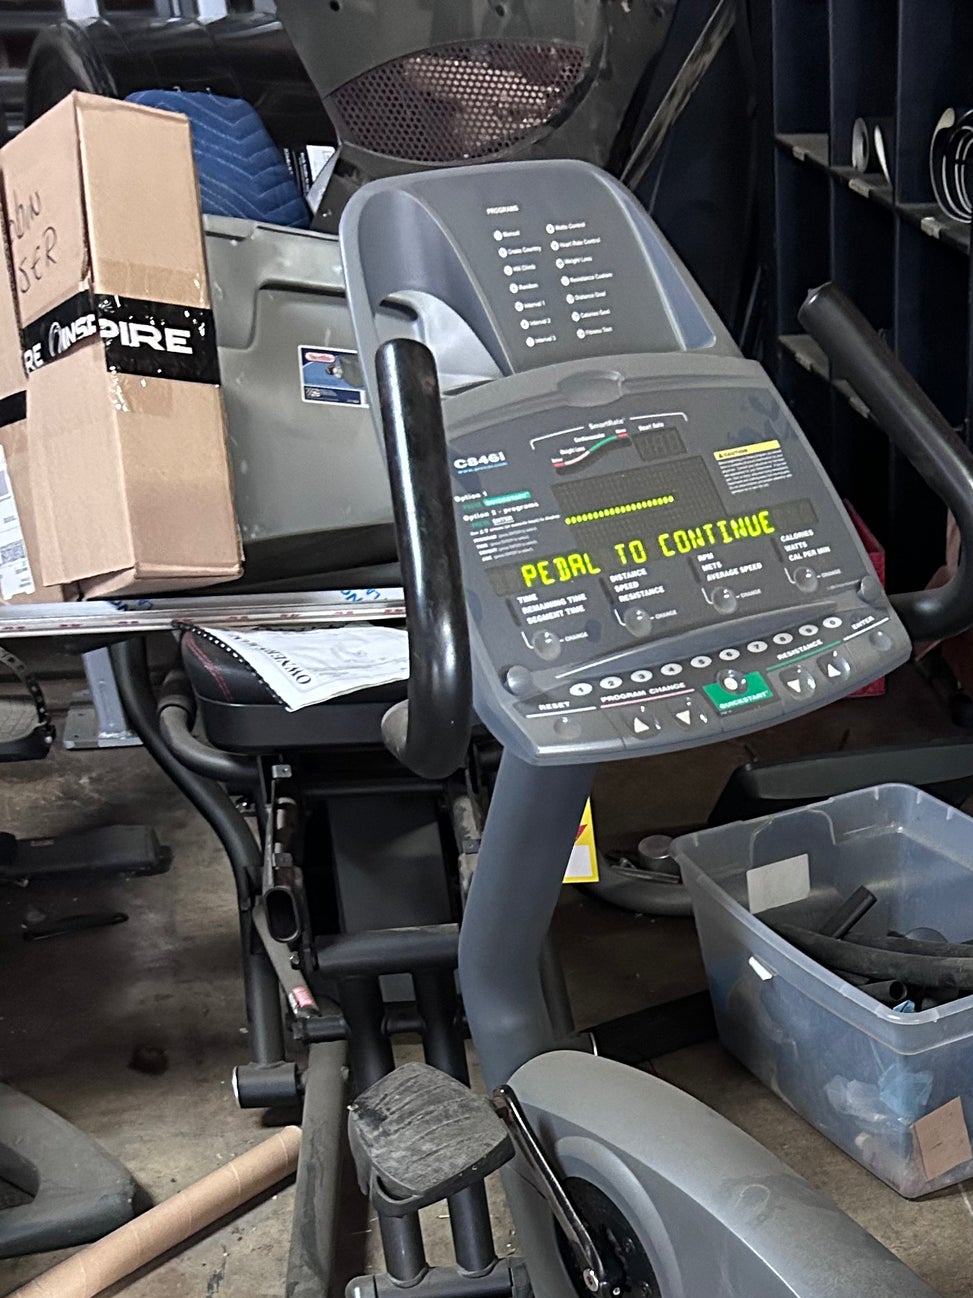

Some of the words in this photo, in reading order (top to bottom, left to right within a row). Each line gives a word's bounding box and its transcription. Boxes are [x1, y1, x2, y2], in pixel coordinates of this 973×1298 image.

[453, 491, 481, 503] Option
[462, 511, 489, 522] Option
[503, 501, 540, 514] programs
[780, 529, 814, 543] CALORIES
[521, 553, 601, 588] PEDAL
[614, 540, 648, 565] TO
[658, 510, 775, 557] CONTINUE
[784, 541, 808, 552] WATTS
[788, 552, 804, 562] CAL
[803, 549, 817, 557] PER
[817, 546, 831, 555] MIN
[697, 552, 714, 562] RPM
[701, 561, 722, 572] METS
[706, 566, 740, 582] AVERAGE
[739, 562, 763, 574] SPEED
[609, 568, 648, 583] DISTANCE
[614, 581, 640, 593] SPEED
[618, 586, 665, 603] RESISTANCE
[516, 593, 538, 604] TIME
[521, 598, 567, 615] REMAINING
[566, 593, 587, 603] TIME
[526, 611, 565, 625] SEGMENT
[565, 605, 586, 616] TIME
[851, 615, 875, 630] ENTER
[776, 639, 824, 661] RESISTANCE
[600, 690, 647, 703] PROGRAM
[649, 682, 686, 695] CHANGE
[538, 701, 570, 711] RESET
[719, 691, 768, 710] QUICKSTART
